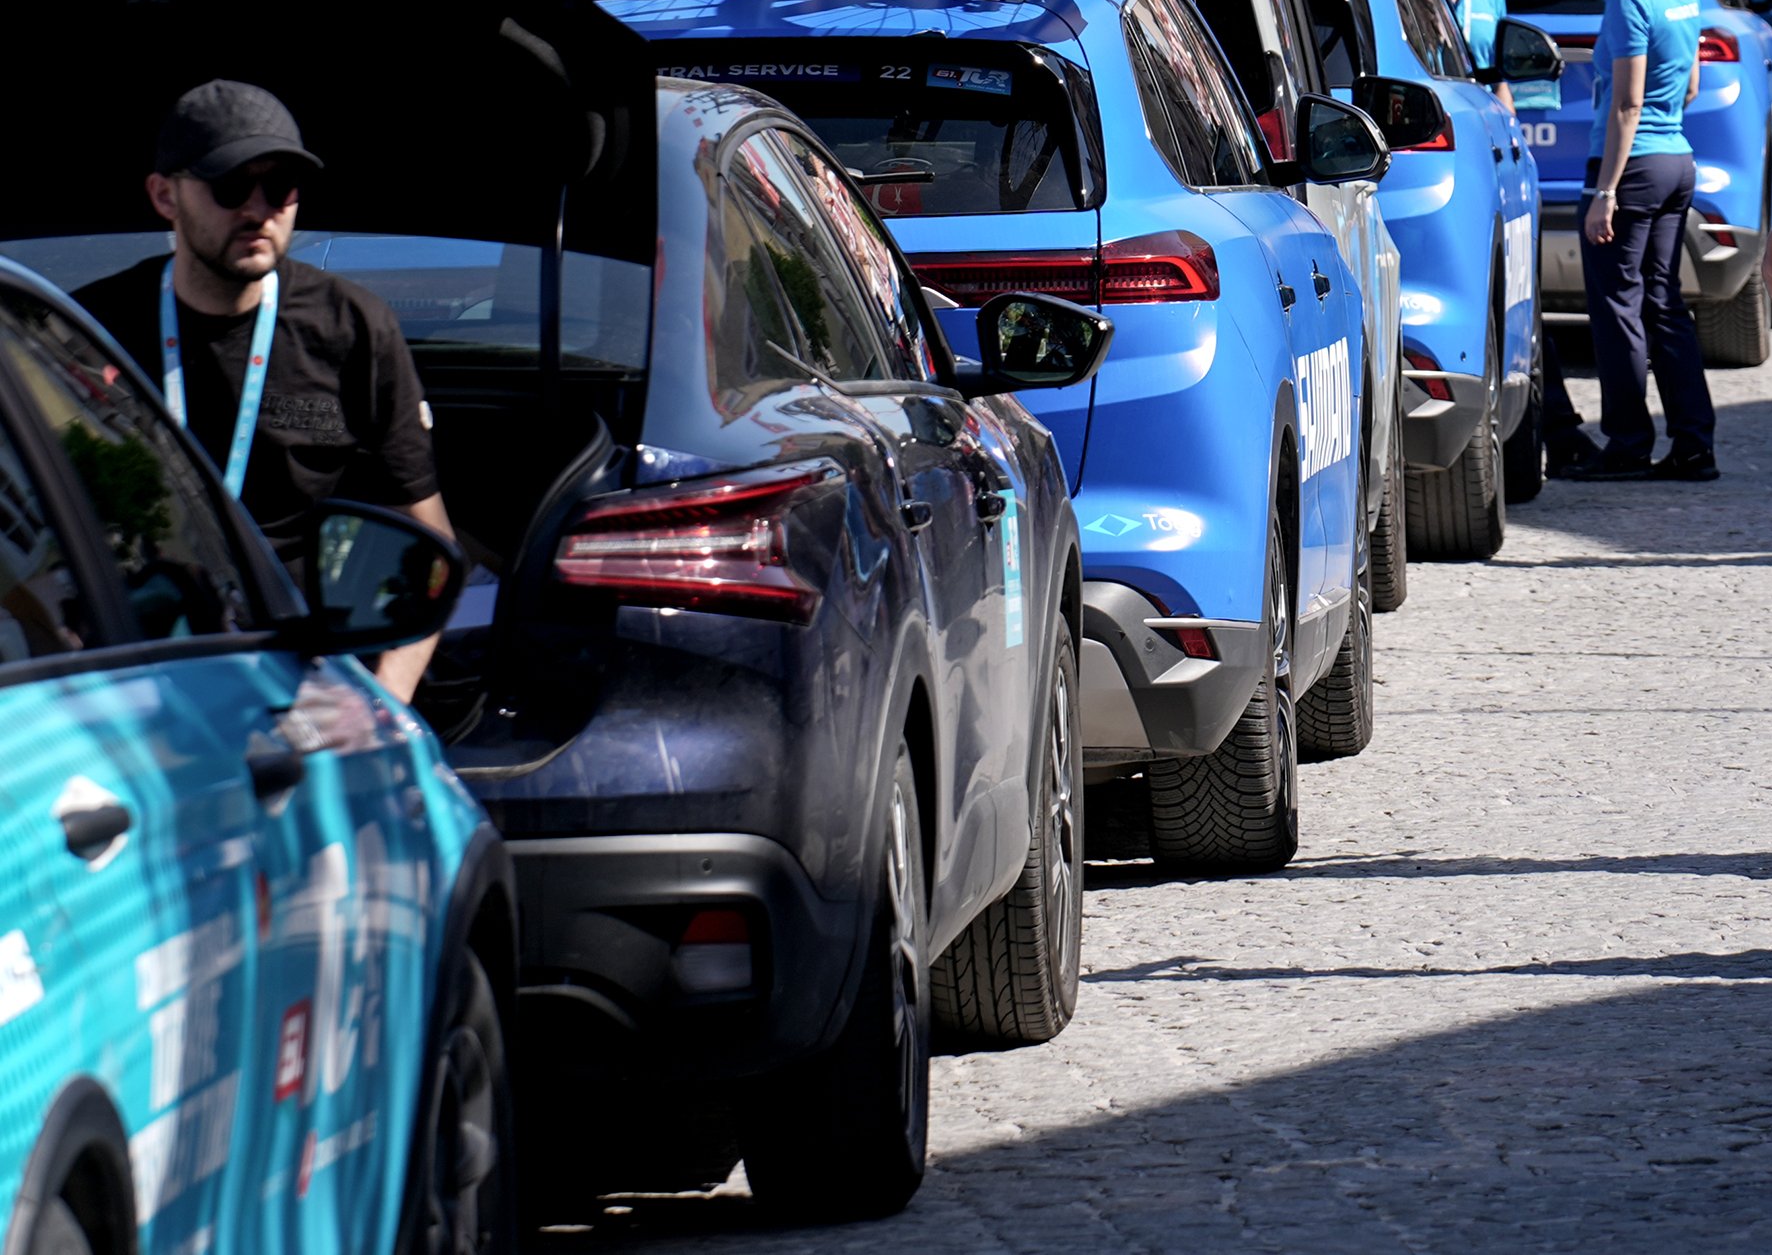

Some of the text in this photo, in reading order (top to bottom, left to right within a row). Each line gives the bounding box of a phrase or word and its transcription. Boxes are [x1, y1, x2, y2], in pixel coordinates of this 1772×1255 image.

[728, 64, 840, 77] SERVICE
[879, 65, 912, 80] 22
[1298, 336, 1352, 485] SHIMANO
